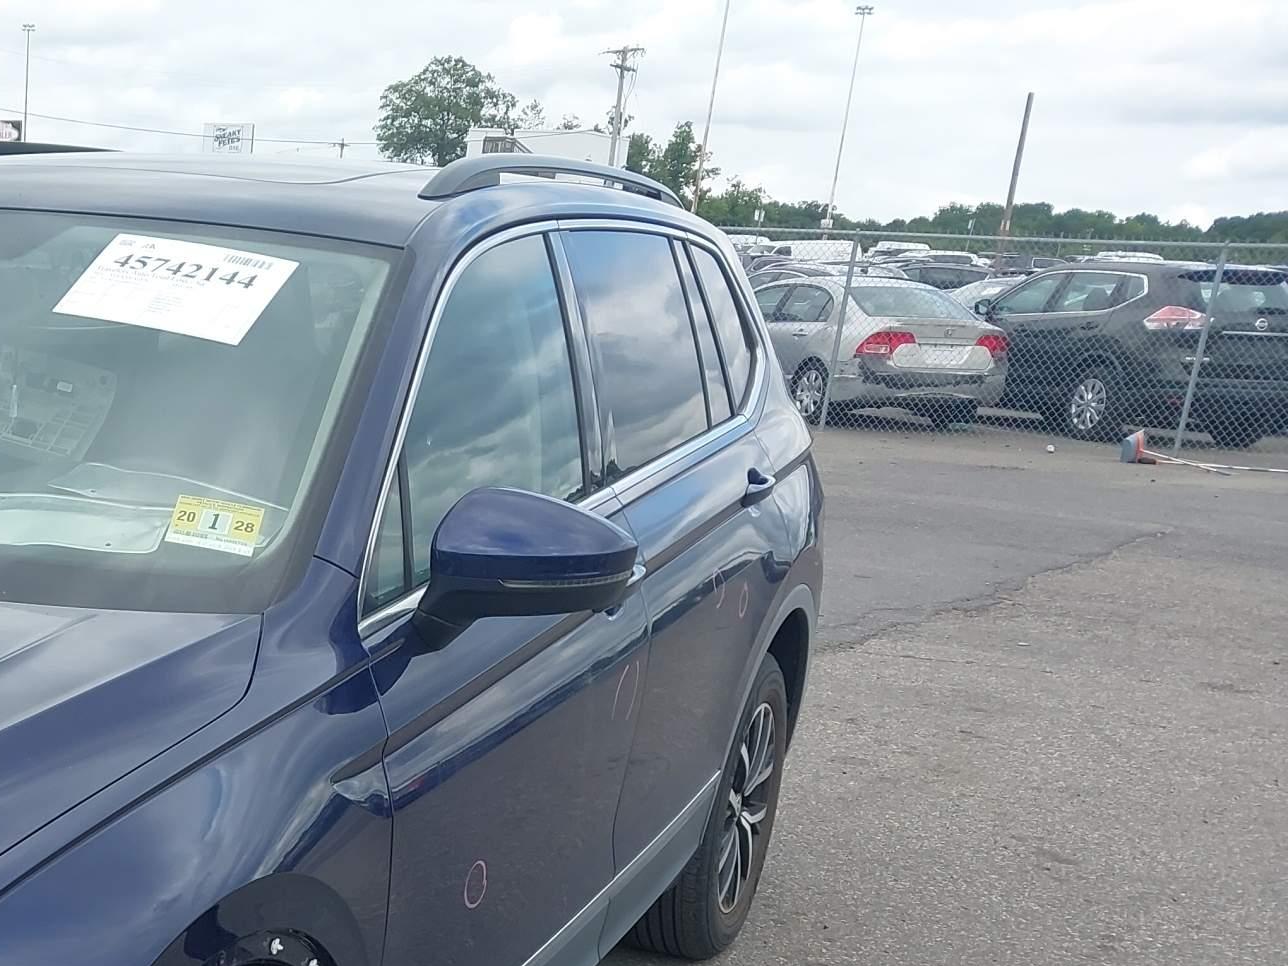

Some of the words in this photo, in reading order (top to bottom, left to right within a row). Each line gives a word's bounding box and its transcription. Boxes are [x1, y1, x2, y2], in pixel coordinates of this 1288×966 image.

[113, 254, 258, 289] 45742144
[176, 510, 197, 523] 20
[208, 513, 220, 530] 1
[233, 520, 255, 533] 28
